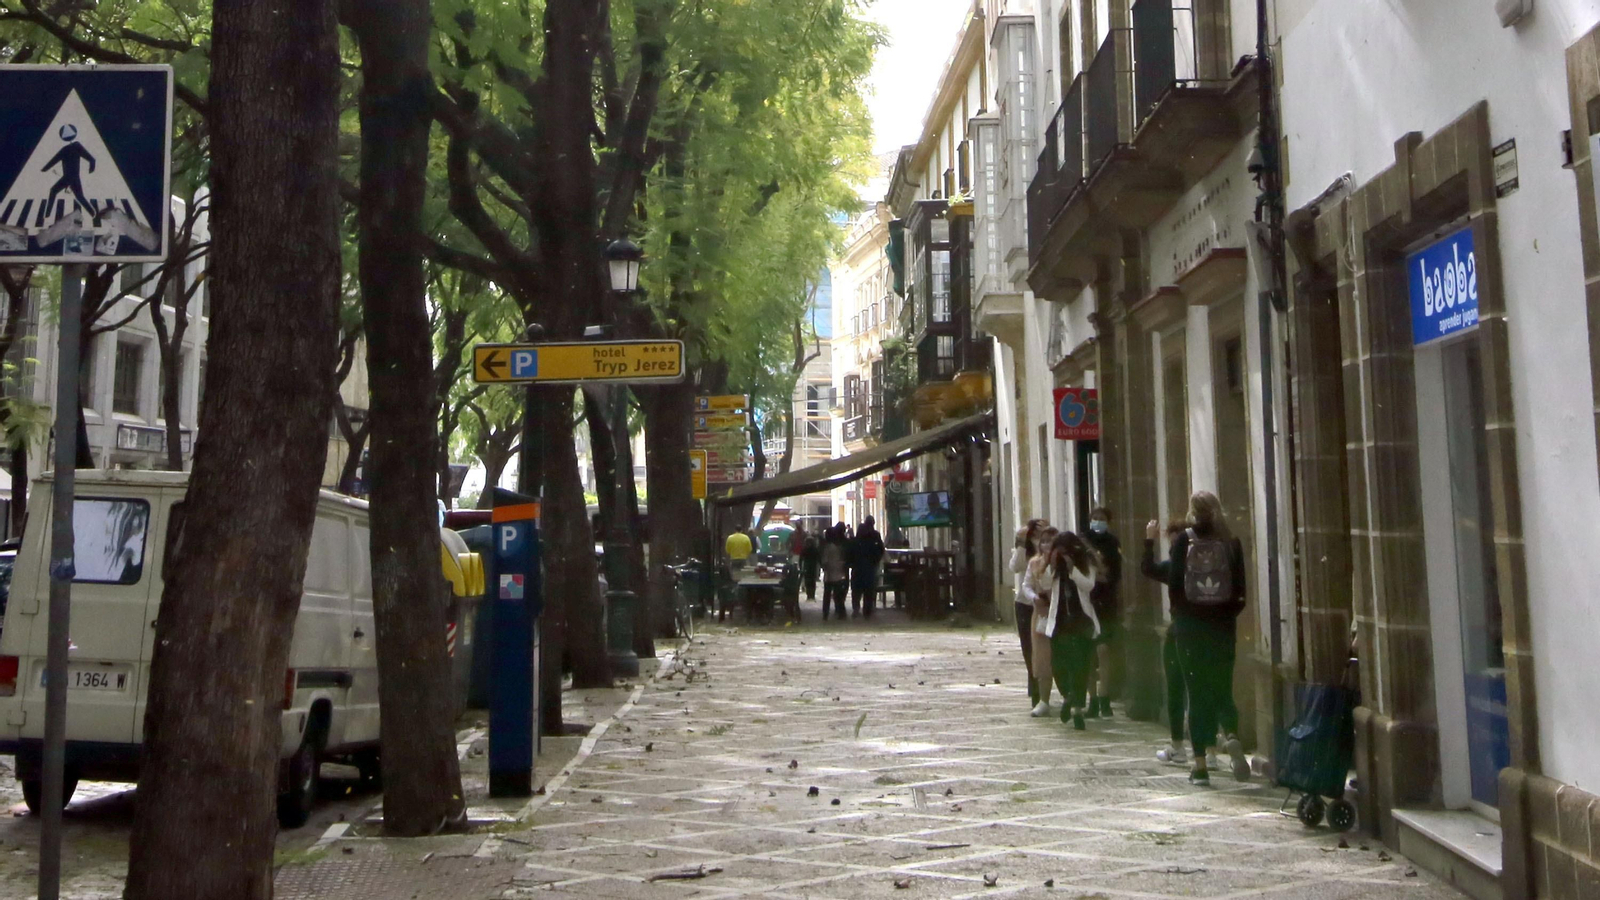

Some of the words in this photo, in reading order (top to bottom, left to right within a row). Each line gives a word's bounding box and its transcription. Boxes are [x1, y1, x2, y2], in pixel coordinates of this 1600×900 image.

[1439, 311, 1462, 334] aprender
[592, 347, 626, 358] hotel
[515, 352, 533, 375] P
[593, 359, 628, 375] Tryp
[633, 358, 676, 372] Jerez
[1058, 428, 1079, 436] EURO
[501, 525, 517, 551] P
[76, 672, 108, 687] 1364
[117, 673, 126, 688] W
